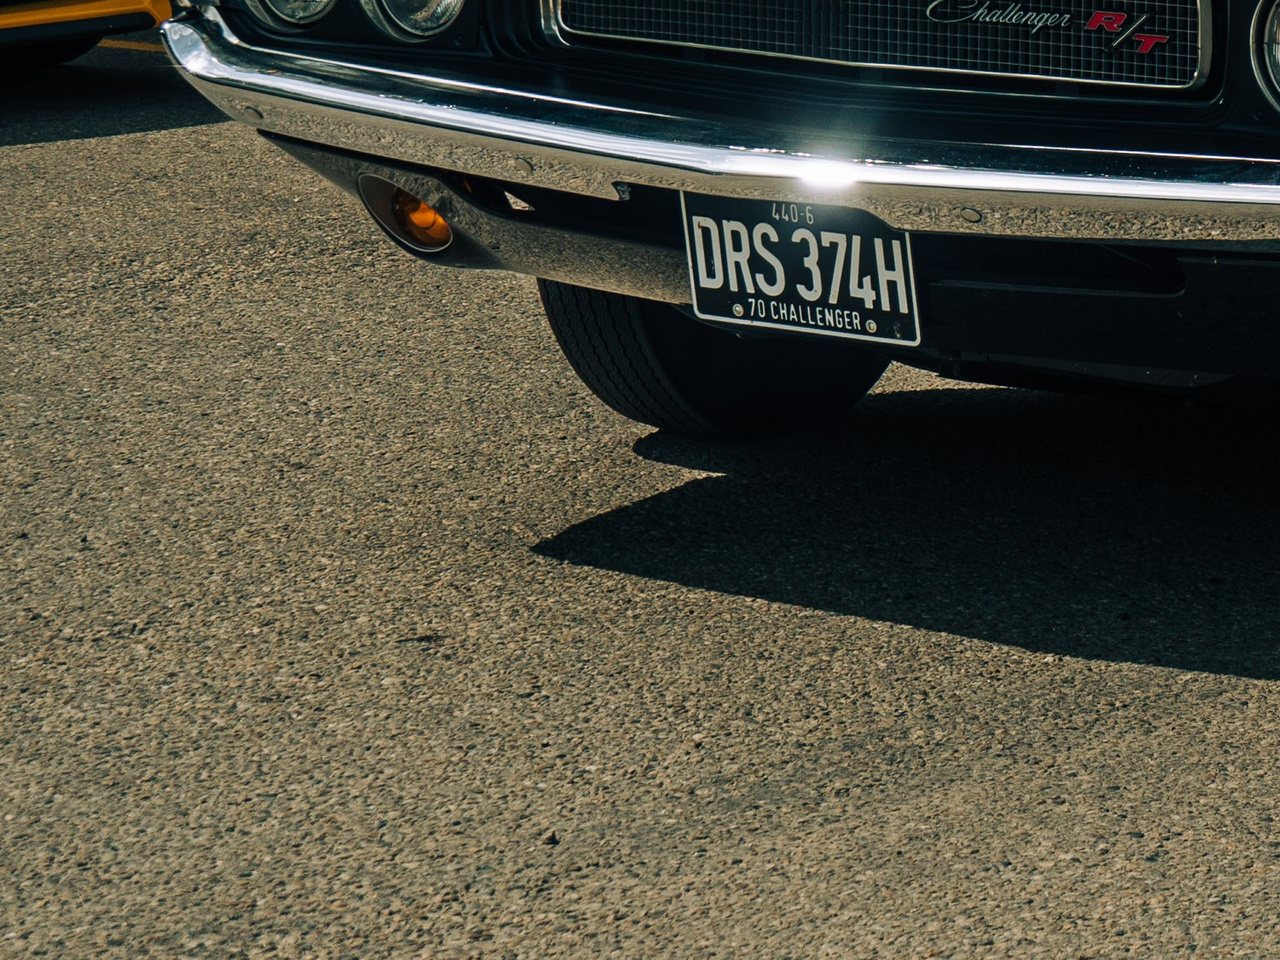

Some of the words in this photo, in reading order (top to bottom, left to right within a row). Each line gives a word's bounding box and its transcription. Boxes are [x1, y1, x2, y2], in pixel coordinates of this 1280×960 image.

[1084, 10, 1169, 54] R/T
[772, 202, 814, 225] 440-6
[692, 215, 786, 297] DRS
[791, 228, 909, 314] 374H
[748, 298, 766, 318] 70
[770, 301, 861, 331] CHALLENGER
